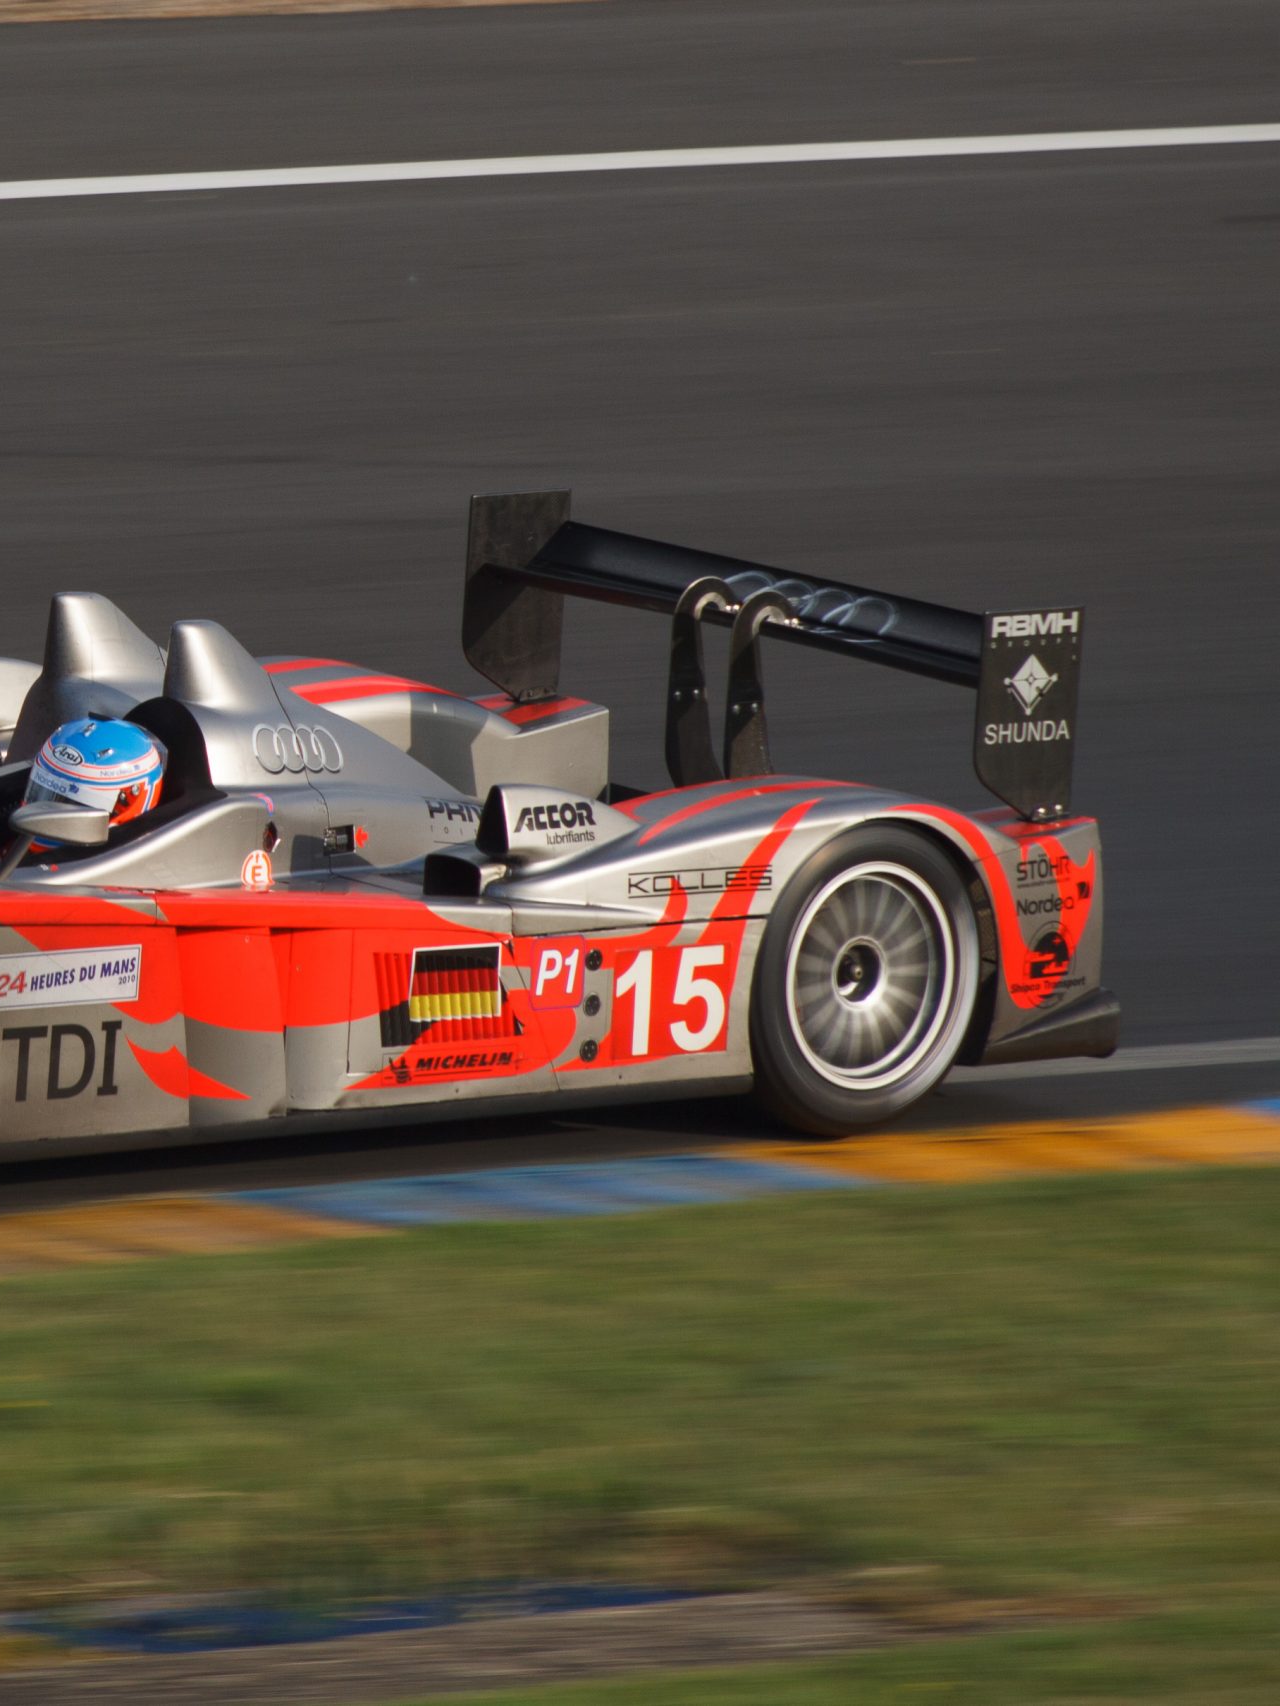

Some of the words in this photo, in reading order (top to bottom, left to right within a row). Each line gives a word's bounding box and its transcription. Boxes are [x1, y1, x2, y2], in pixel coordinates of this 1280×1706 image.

[991, 611, 1079, 638] RBMH
[984, 719, 1070, 745] SHUNDA
[57, 746, 79, 763] Arai
[34, 772, 67, 793] Nordea
[514, 802, 597, 833] ACCOR
[546, 831, 596, 845] lubrifiants
[1016, 853, 1070, 881] STÖHR
[628, 870, 772, 894] KOLLES
[1016, 894, 1074, 917] Nordea
[30, 969, 75, 991] HEURES
[80, 965, 96, 981] DU
[100, 957, 136, 978] MANS
[118, 975, 136, 985] 2010
[536, 949, 579, 996] P1
[616, 945, 725, 1056] 15
[2, 1020, 122, 1102] TDI
[417, 1052, 513, 1071] MICHELIN
